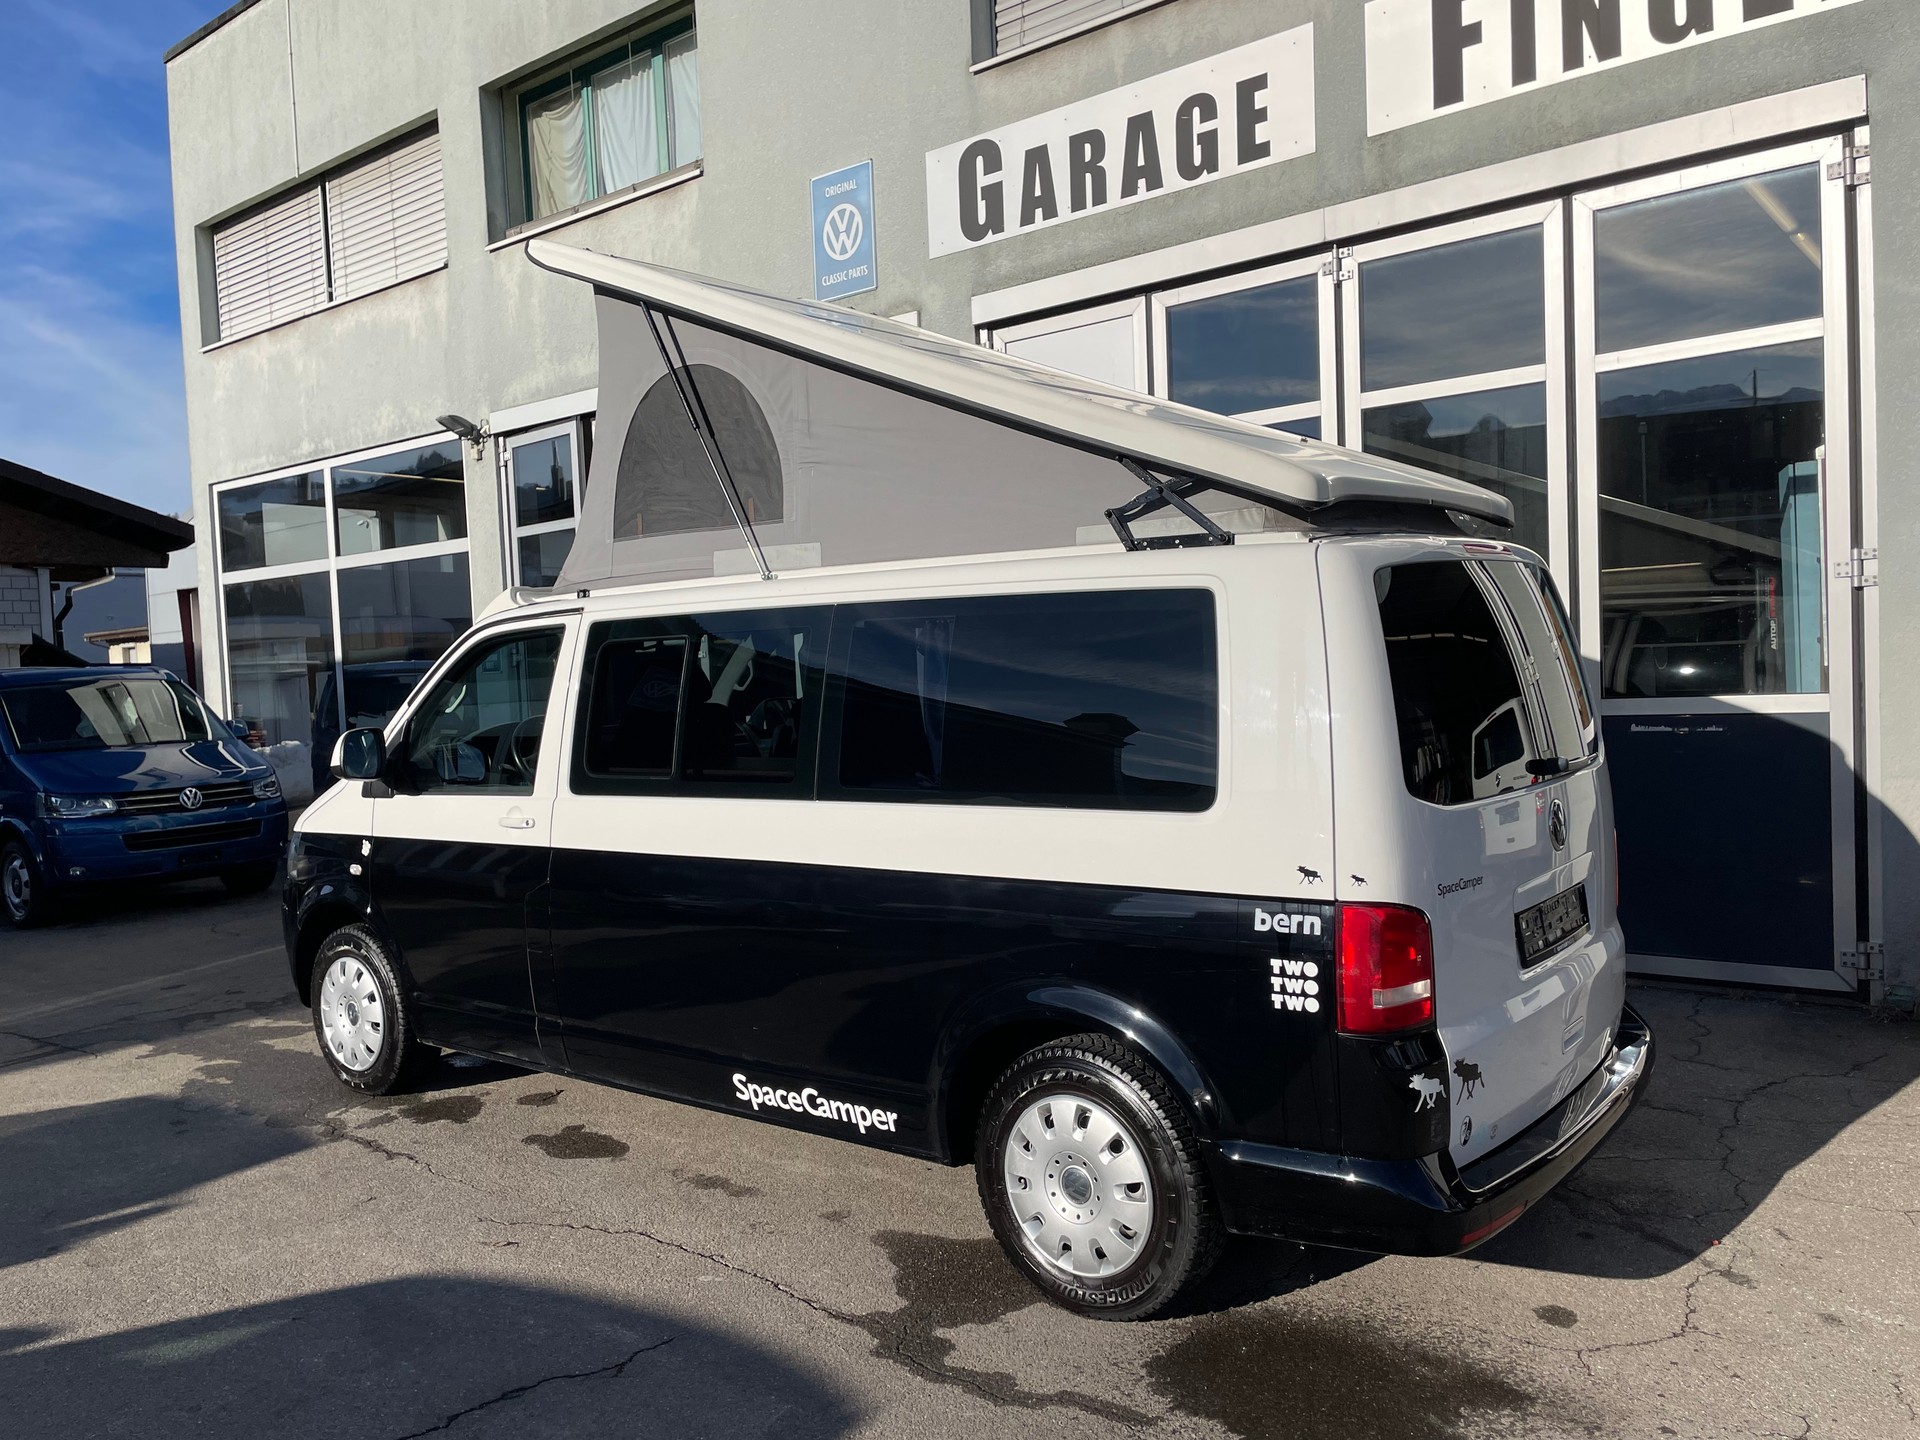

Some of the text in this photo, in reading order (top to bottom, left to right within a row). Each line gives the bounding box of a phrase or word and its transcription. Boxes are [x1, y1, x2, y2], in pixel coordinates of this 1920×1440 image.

[958, 73, 1271, 242] GARAGE
[825, 179, 857, 198] ORIGINAL
[823, 203, 863, 261] VW
[821, 265, 869, 286] CLASSIC PARTS
[1437, 876, 1484, 899] SpaceCamper
[1254, 907, 1322, 936] bern
[1270, 958, 1319, 977] TWO
[1270, 976, 1319, 995] TWO
[1271, 993, 1320, 1013] TWO
[732, 1072, 898, 1135] SpaceCamper
